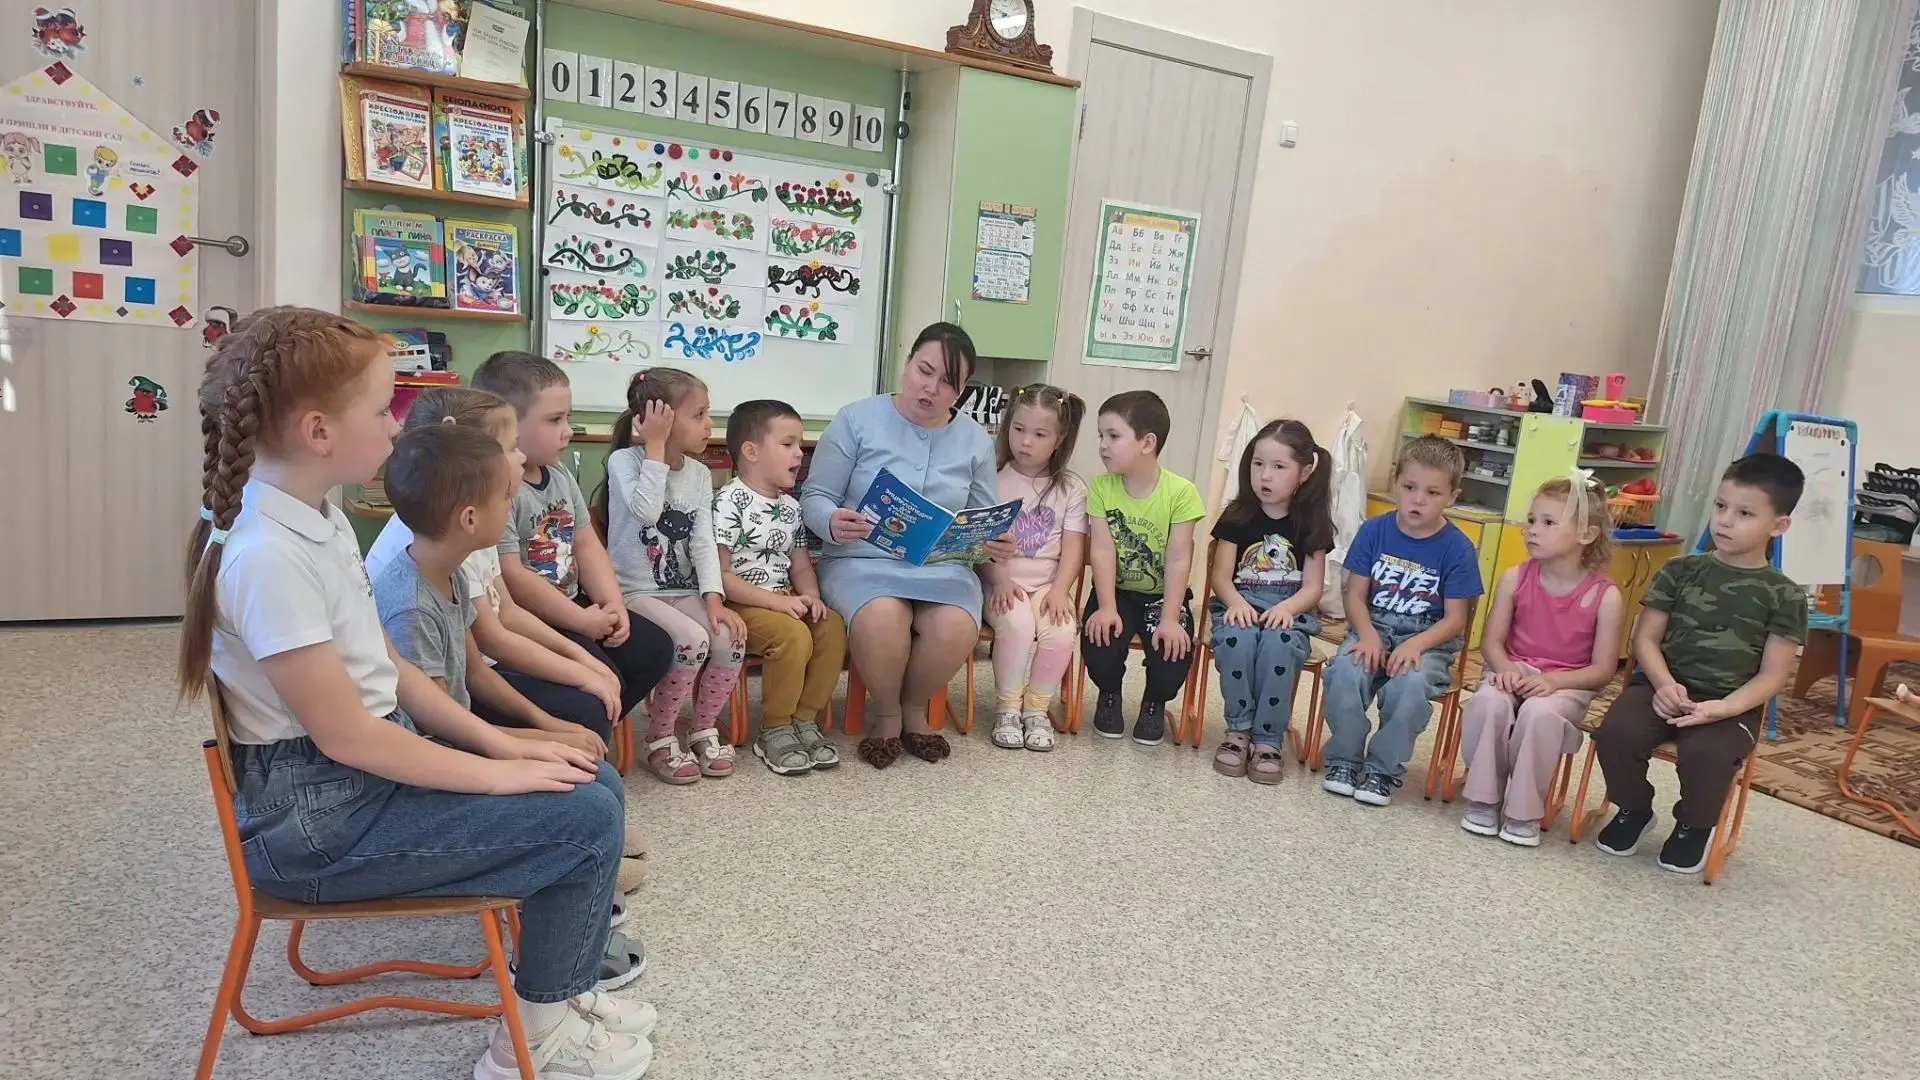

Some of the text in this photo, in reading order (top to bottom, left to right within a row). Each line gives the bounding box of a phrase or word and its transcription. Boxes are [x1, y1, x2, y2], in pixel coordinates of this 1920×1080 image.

[25, 95, 98, 110] ЗДРАВСТВУЙТЕ,
[552, 62, 882, 144] 0 1 2 3 4 5 6 7 8 9 10
[368, 103, 426, 119] ХРЕСТОМАТИЯ
[6, 119, 49, 131] ПРИШЛИ
[50, 125, 57, 133] В
[59, 126, 102, 138] ДЕТСКИЙ
[104, 133, 122, 142] САД
[453, 117, 508, 131] ХРЕСТОМАТИЯ
[380, 219, 423, 229] ЛЕПИМ
[465, 231, 508, 243] РАСКРАСКА
[1112, 226, 1183, 243] Аа Бб Вв Гг
[1109, 240, 1121, 251] Дд
[1131, 243, 1142, 252] Ее
[1168, 248, 1184, 258] Жж
[1108, 255, 1180, 272] Зз Ии Йй Кк
[1107, 270, 1177, 286] Лл Мм Нн Оо
[1105, 285, 1175, 300] Пп Рр Сс Тт
[1103, 300, 1174, 316] Уу Фф Хх Цц
[1101, 314, 1112, 322] Чч
[1119, 316, 1135, 325] Шш
[1139, 319, 1155, 329] Щщ
[1122, 332, 1133, 340] Ээ
[1138, 333, 1154, 342] Юю
[1159, 335, 1171, 344] Яя
[1127, 515, 1158, 534] SAURUS
